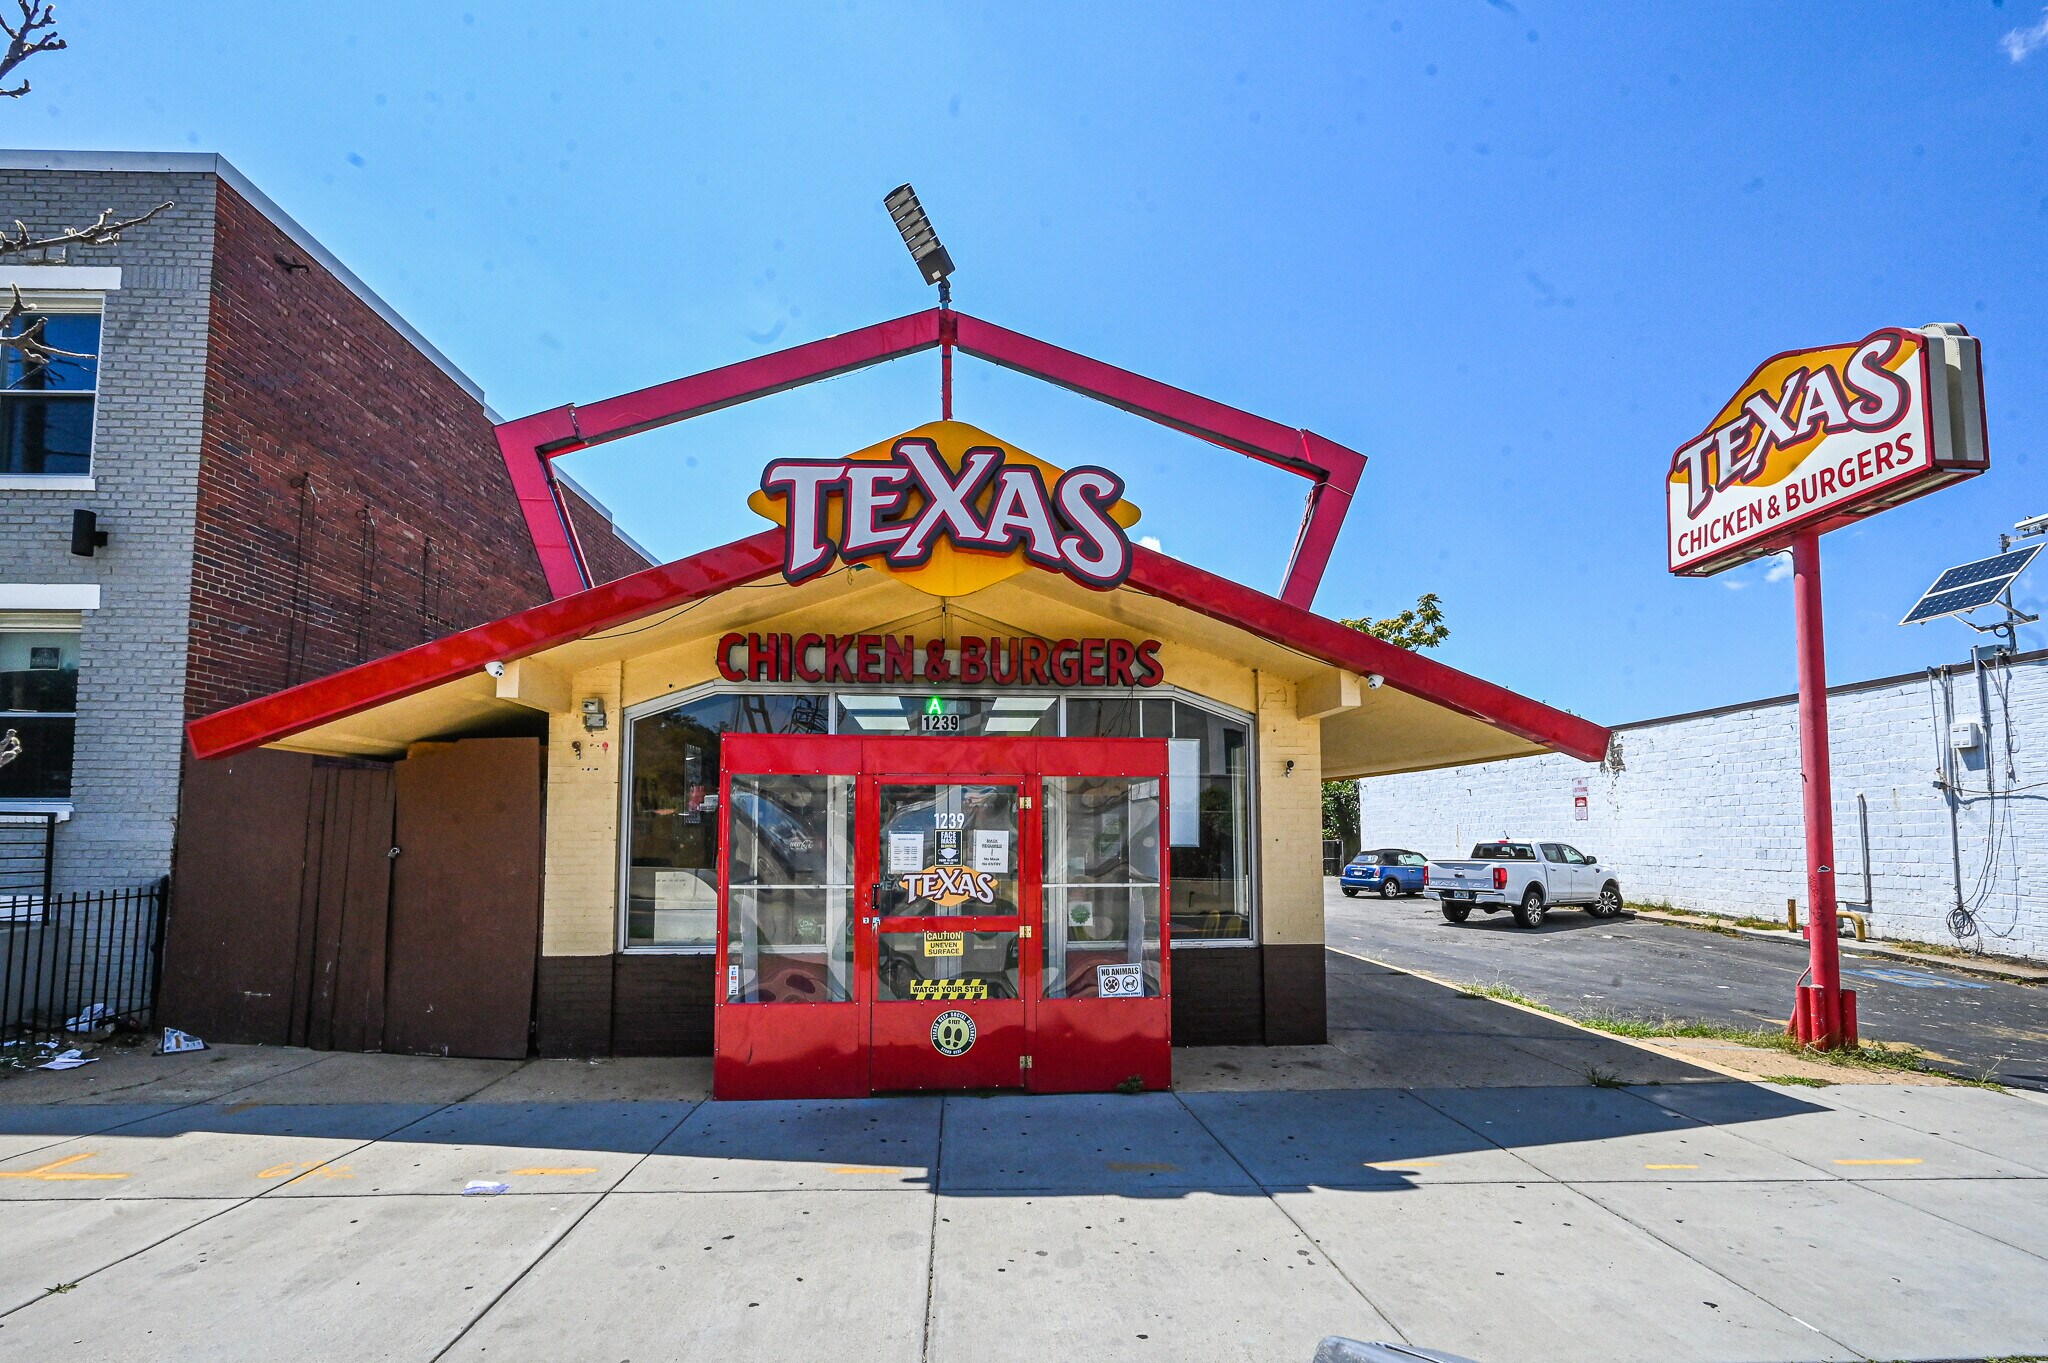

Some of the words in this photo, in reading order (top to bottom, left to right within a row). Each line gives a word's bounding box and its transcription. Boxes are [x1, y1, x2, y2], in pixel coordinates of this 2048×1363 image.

[1676, 332, 1911, 519] TEXAS
[1677, 499, 1763, 557] CHICKEN
[1767, 496, 1780, 520] &
[1786, 432, 1914, 512] BURGERS
[761, 438, 1132, 590] TEXAS
[716, 632, 914, 683] CHICKEN
[925, 639, 951, 682] &
[961, 635, 1165, 687] BURGERS
[929, 698, 942, 714] A
[923, 715, 958, 730] 1239
[934, 813, 964, 829] 1239
[941, 831, 957, 839] FACE
[902, 868, 995, 904] TEXAS
[927, 932, 961, 940] CAUTION
[1111, 967, 1139, 975] ANIMALS
[965, 985, 984, 993] STEP
